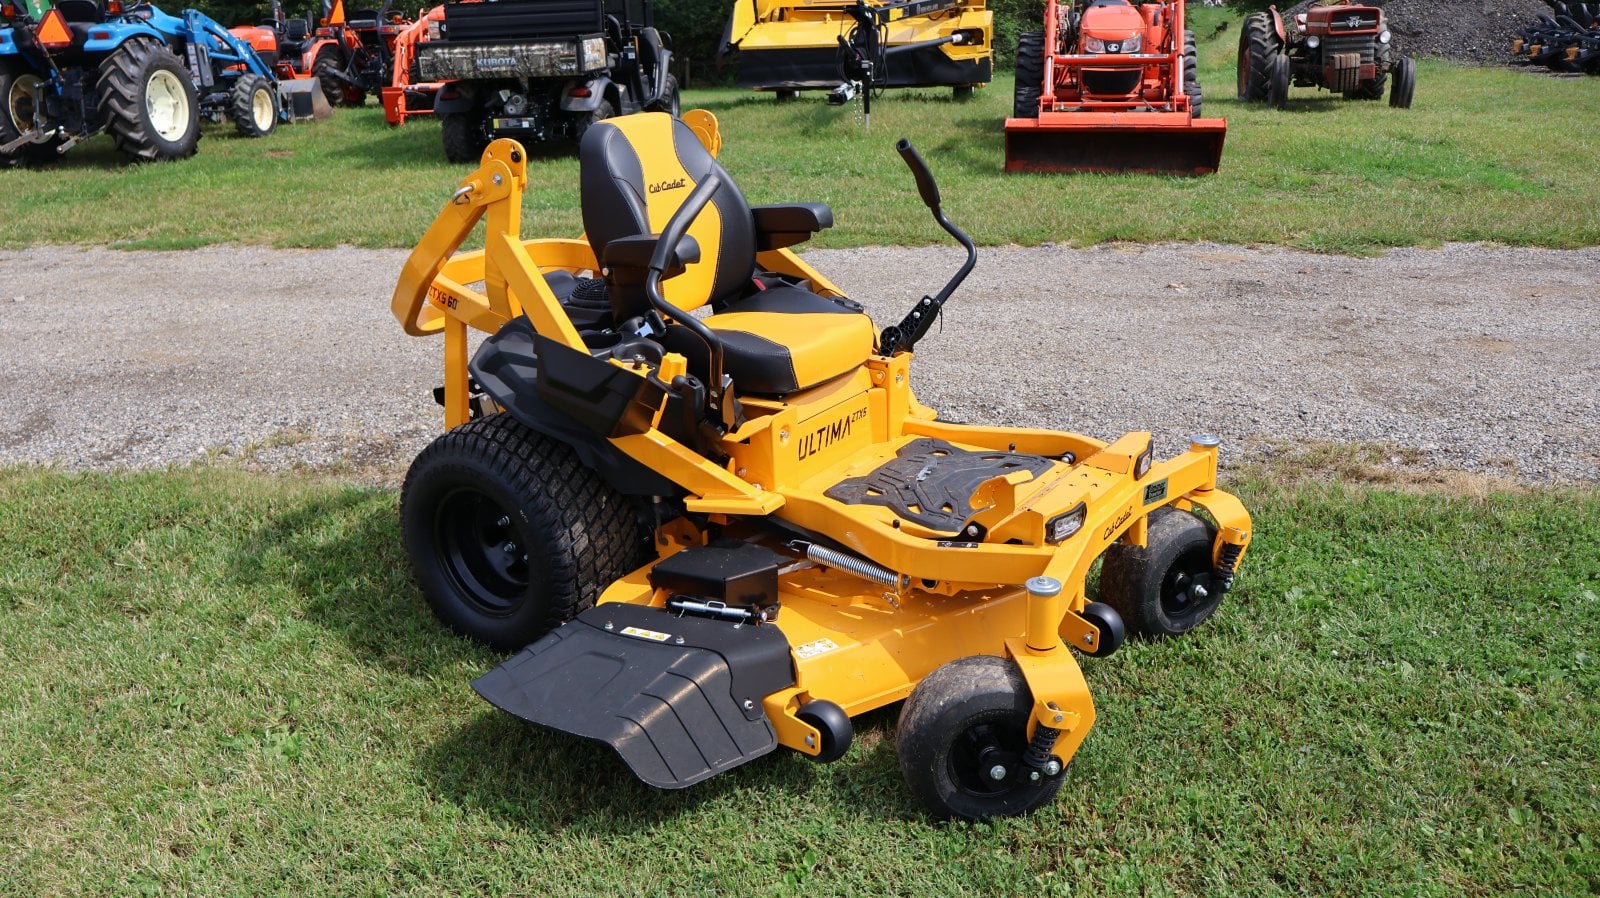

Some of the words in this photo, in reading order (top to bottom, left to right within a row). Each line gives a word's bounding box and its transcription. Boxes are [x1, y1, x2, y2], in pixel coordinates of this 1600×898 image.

[476, 58, 517, 66] KUBOTA
[649, 183, 661, 193] Cub
[661, 178, 685, 191] Cadet
[447, 296, 458, 310] 60
[798, 415, 851, 461] ULTIMA
[851, 407, 867, 423] ZTX5
